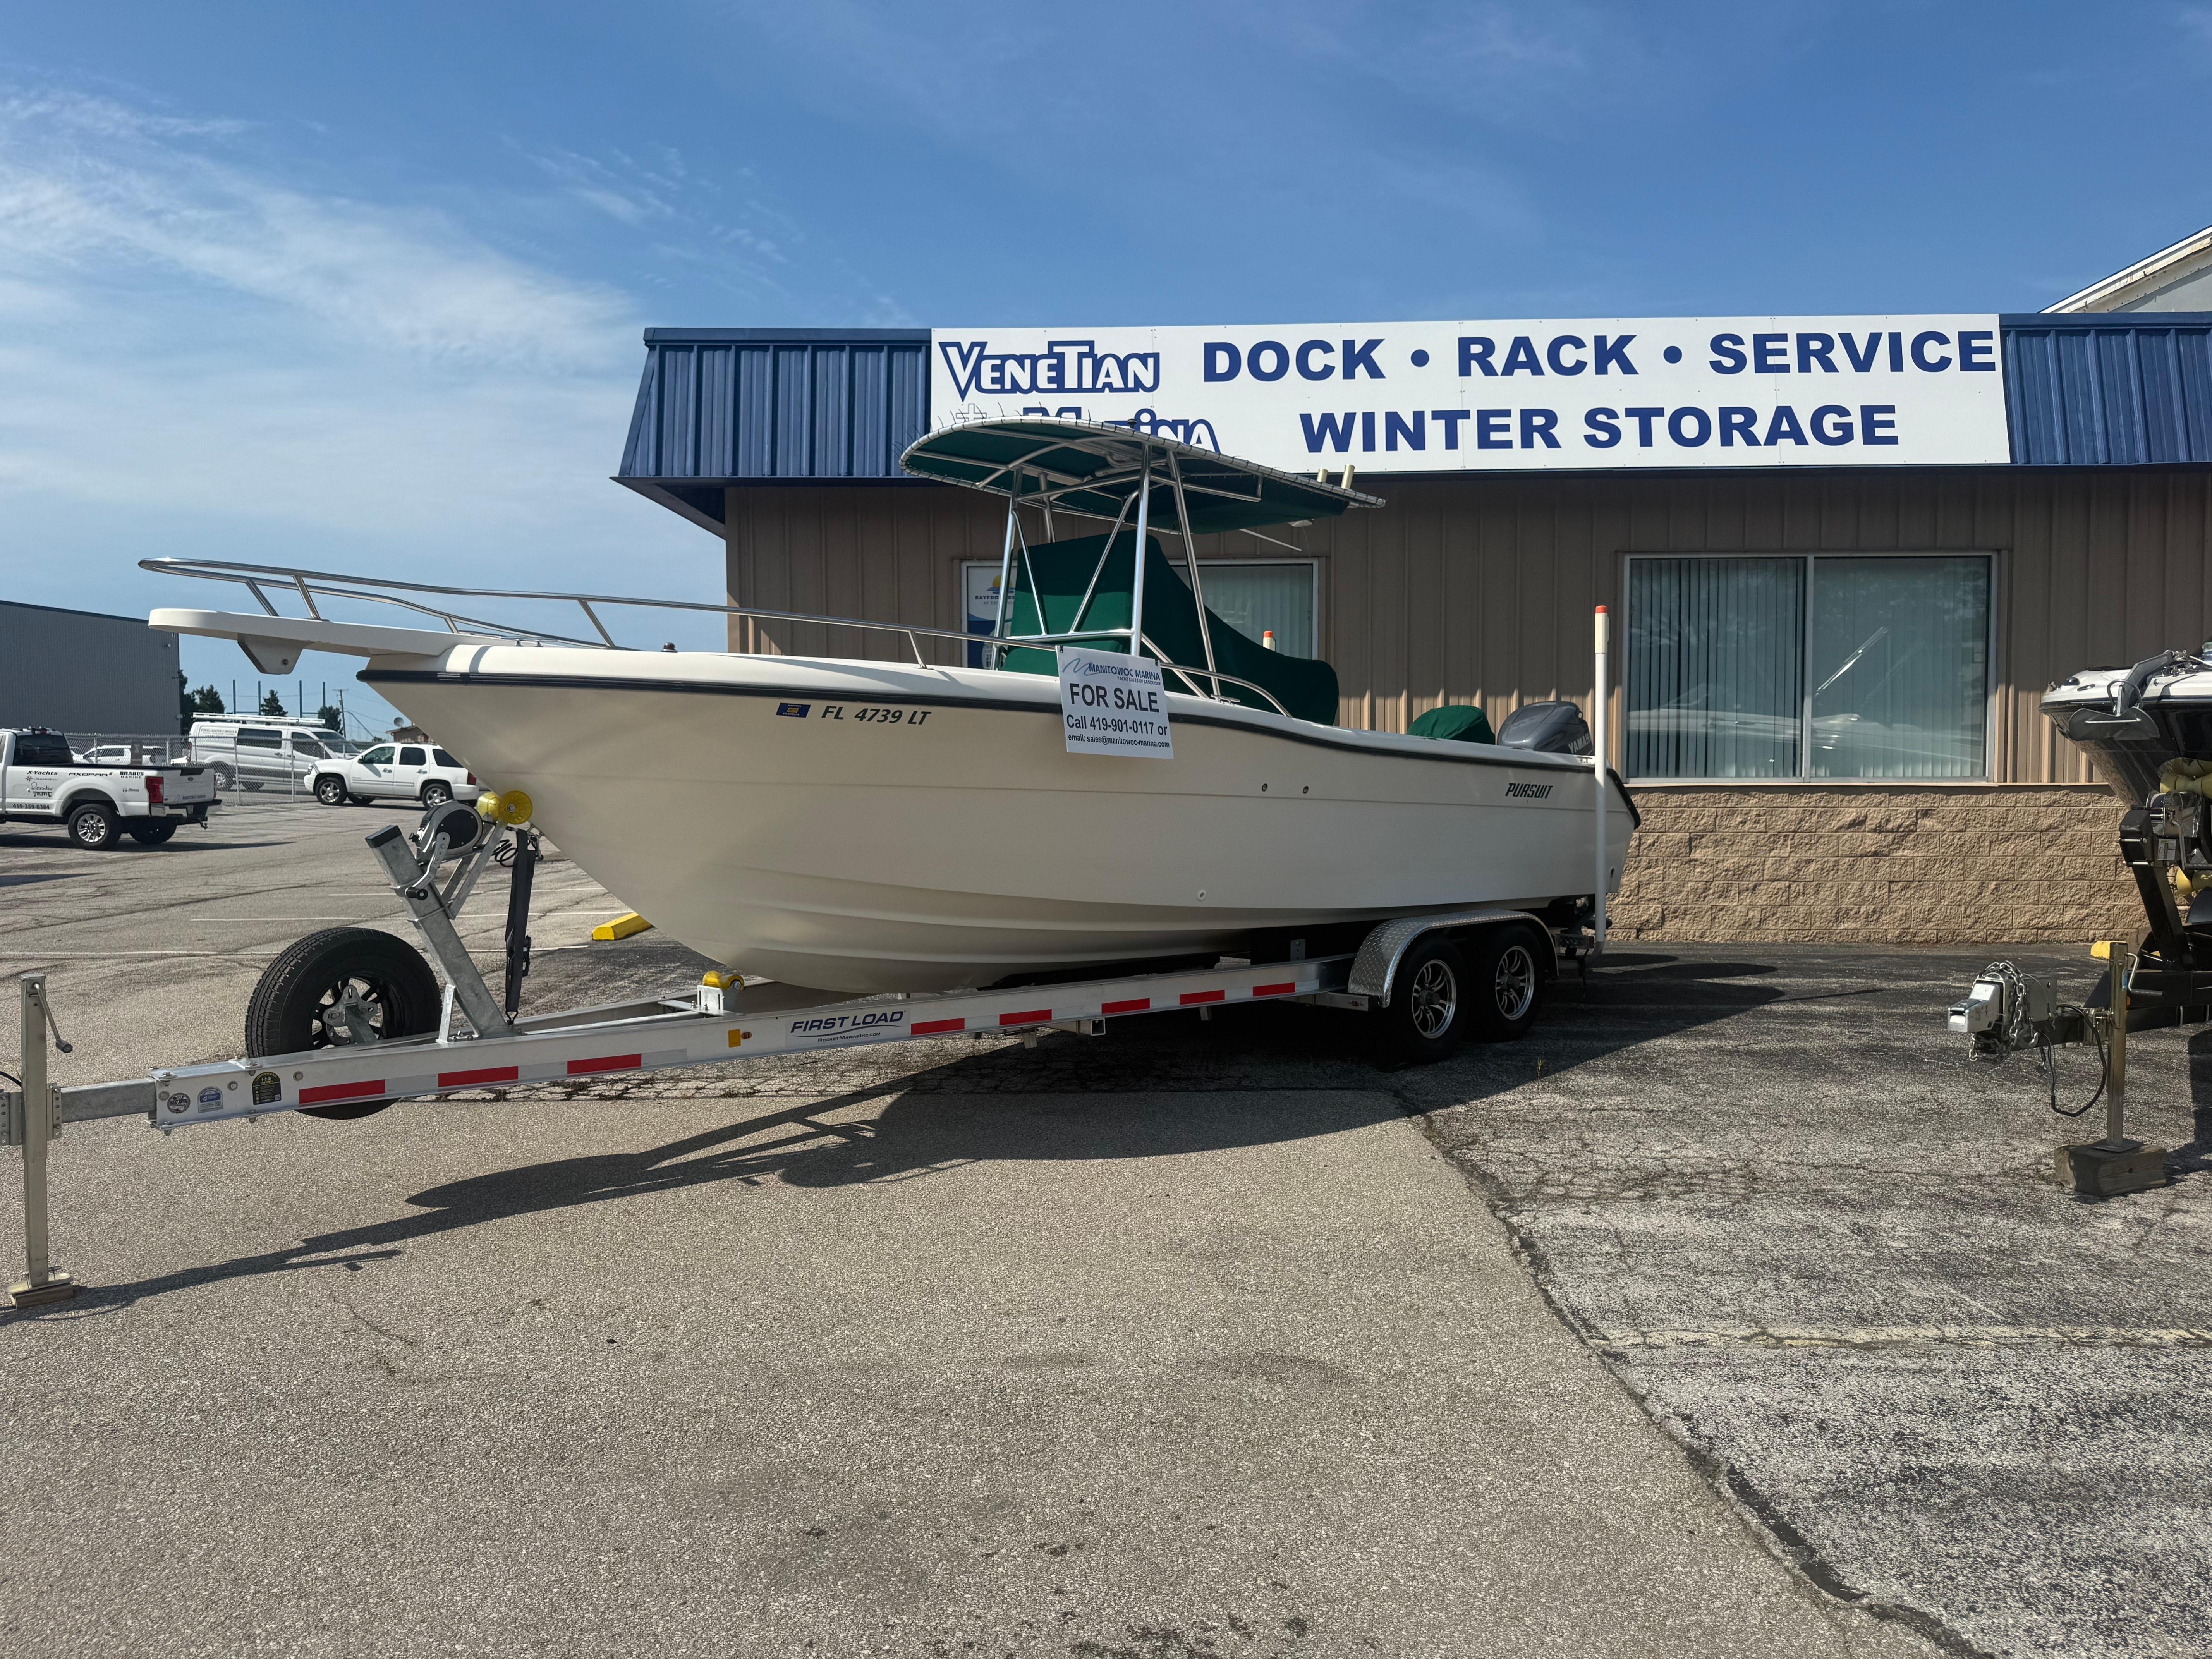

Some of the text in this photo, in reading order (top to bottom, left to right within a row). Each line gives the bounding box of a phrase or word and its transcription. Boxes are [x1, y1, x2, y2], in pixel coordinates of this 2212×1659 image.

[1204, 331, 1996, 382] DOCK RACK SERVICE
[1299, 404, 1899, 453] WINTER STORAGE
[1089, 663, 1161, 681] MANITOWOC MARINA
[1070, 683, 1159, 713] FOR SALE
[821, 706, 932, 725] FL 4739 LT
[1066, 714, 1167, 736] Call 419-901-0117 or
[1068, 734, 1170, 748] email: sales@manitowoc-marina.com
[1505, 783, 1554, 799] PURSUIT
[790, 1011, 904, 1033] FIRST LOAD
